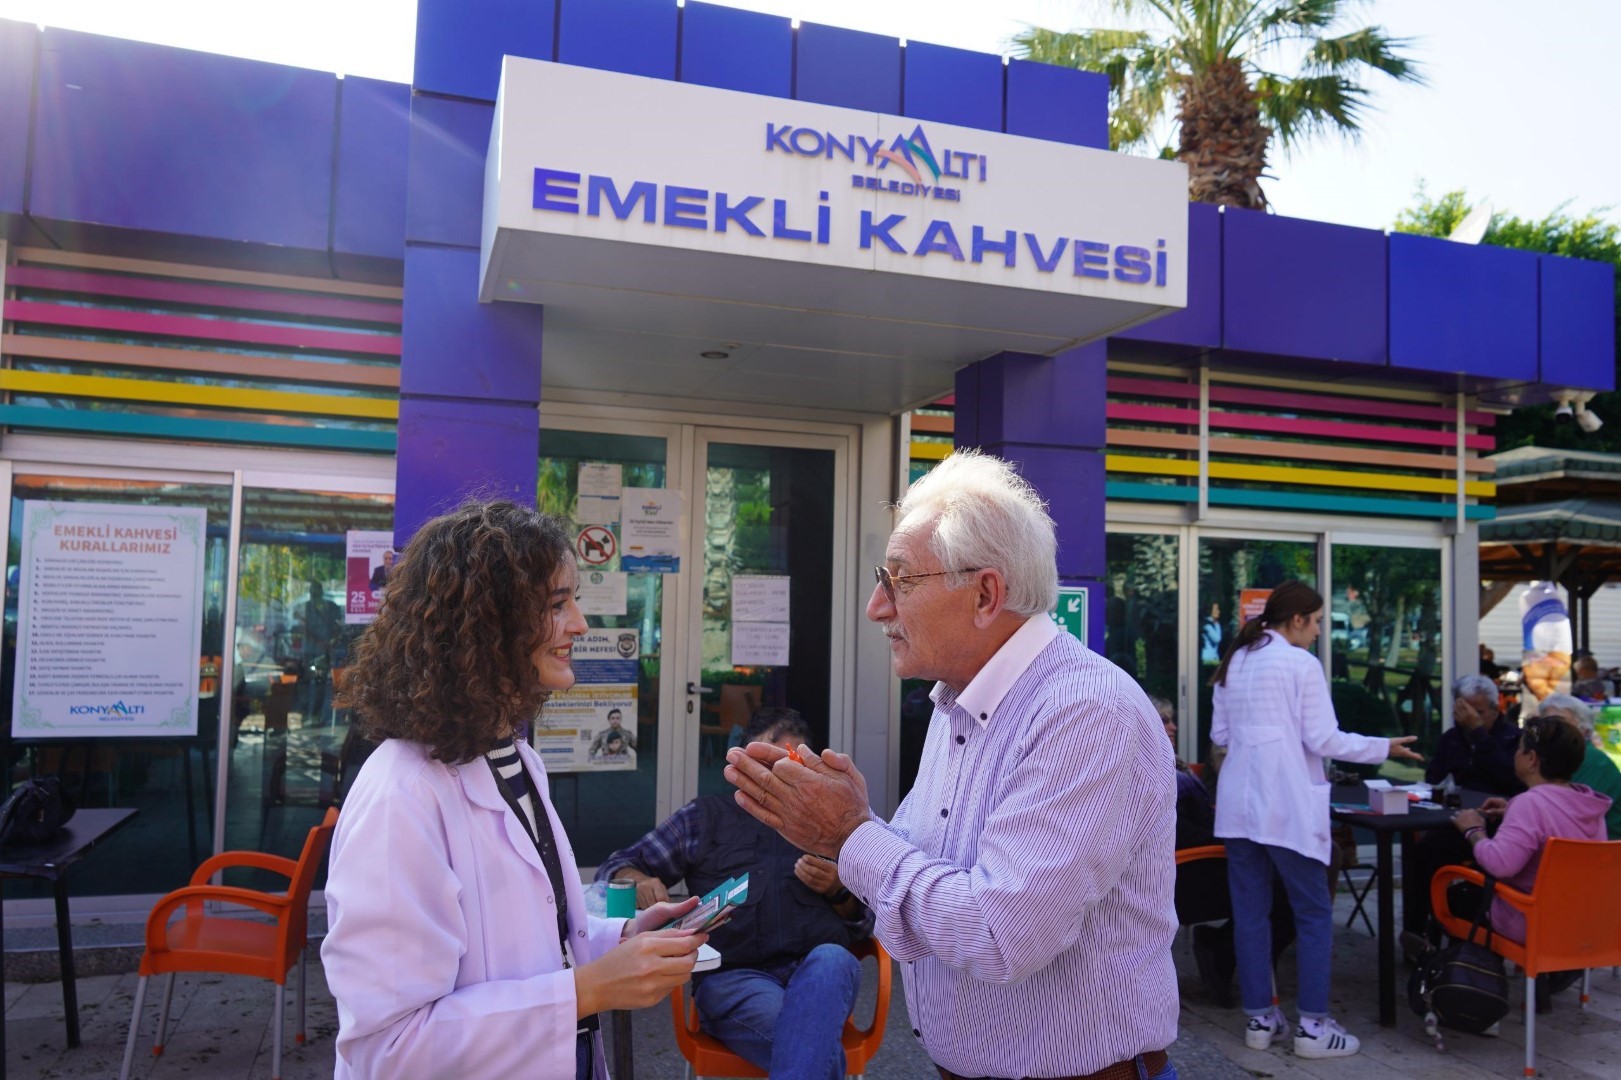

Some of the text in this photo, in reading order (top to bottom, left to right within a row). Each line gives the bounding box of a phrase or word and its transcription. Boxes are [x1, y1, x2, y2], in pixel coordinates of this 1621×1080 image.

[766, 123, 988, 183] KONYAALTI
[532, 167, 1167, 287] EMEKLİ KAHVESİ
[54, 524, 177, 541] EMEKLİ KAHVESİ
[60, 540, 171, 555] KURALLARIMIZ
[351, 591, 366, 603] 25
[70, 700, 144, 717] KONYAALTI
